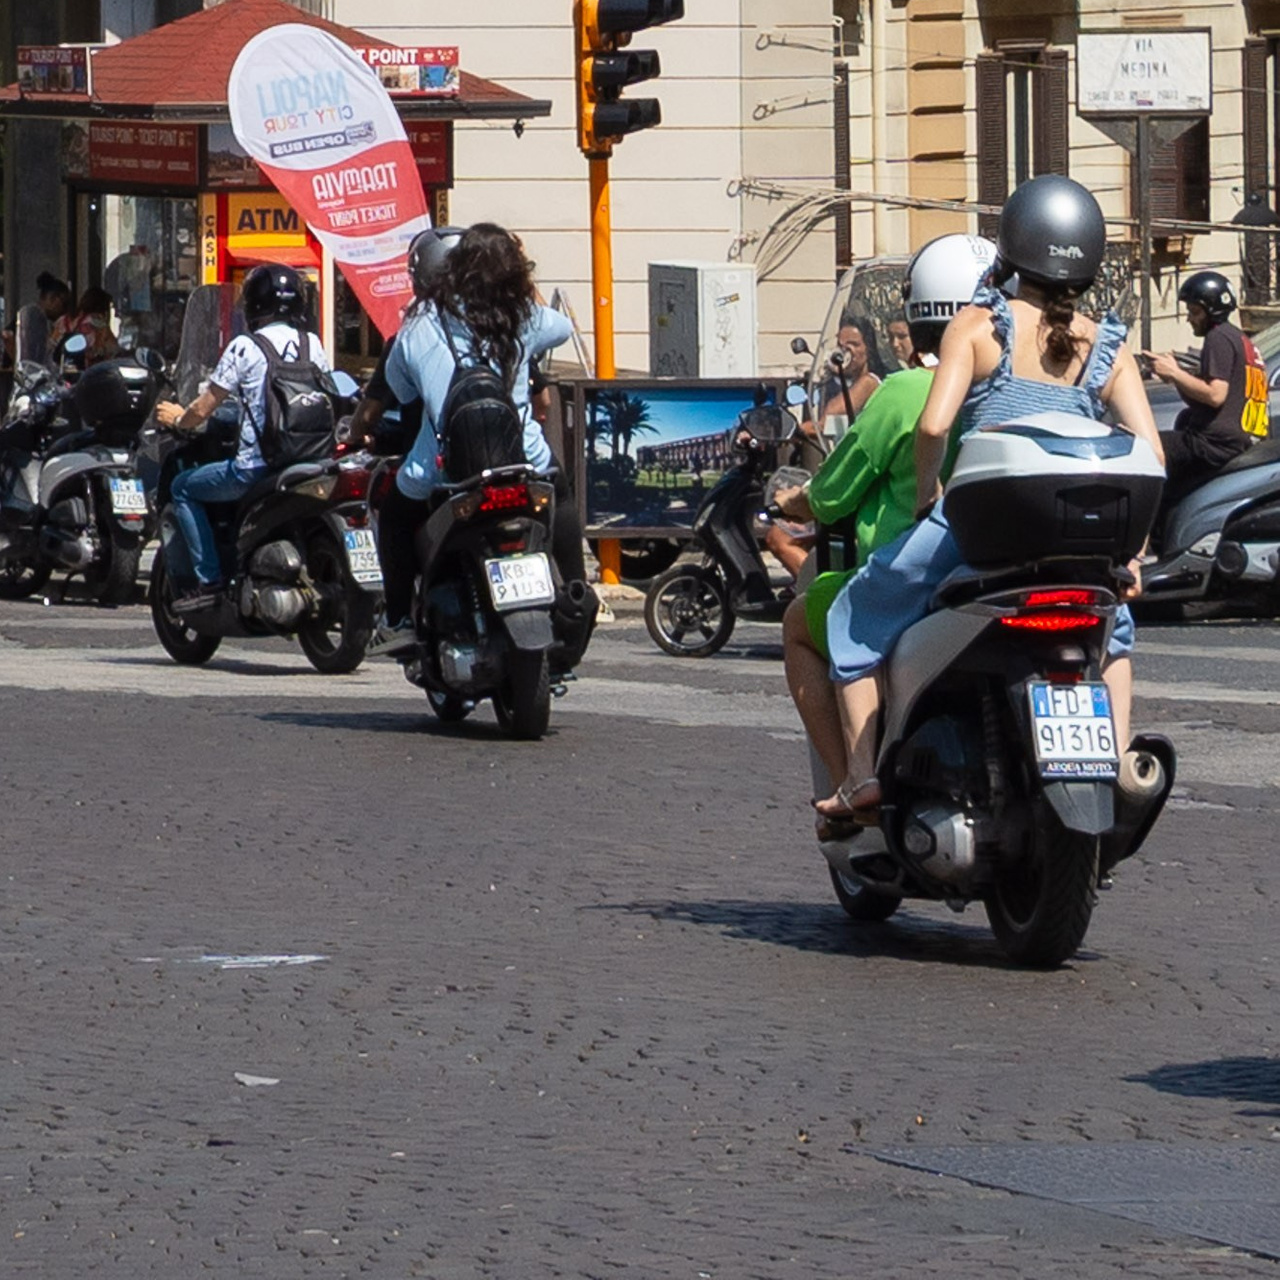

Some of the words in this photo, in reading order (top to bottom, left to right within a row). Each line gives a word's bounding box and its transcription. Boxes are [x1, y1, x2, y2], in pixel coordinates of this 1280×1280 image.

[368, 48, 419, 65] POINT
[1135, 38, 1153, 52] VIA
[1120, 62, 1168, 78] MEDINA
[237, 208, 299, 231] ATM
[438, 192, 448, 227] CAS
[205, 215, 216, 267] CASH
[1051, 687, 1080, 715] FD
[1041, 724, 1111, 752] 91316
[1082, 762, 1112, 773] MOTO
